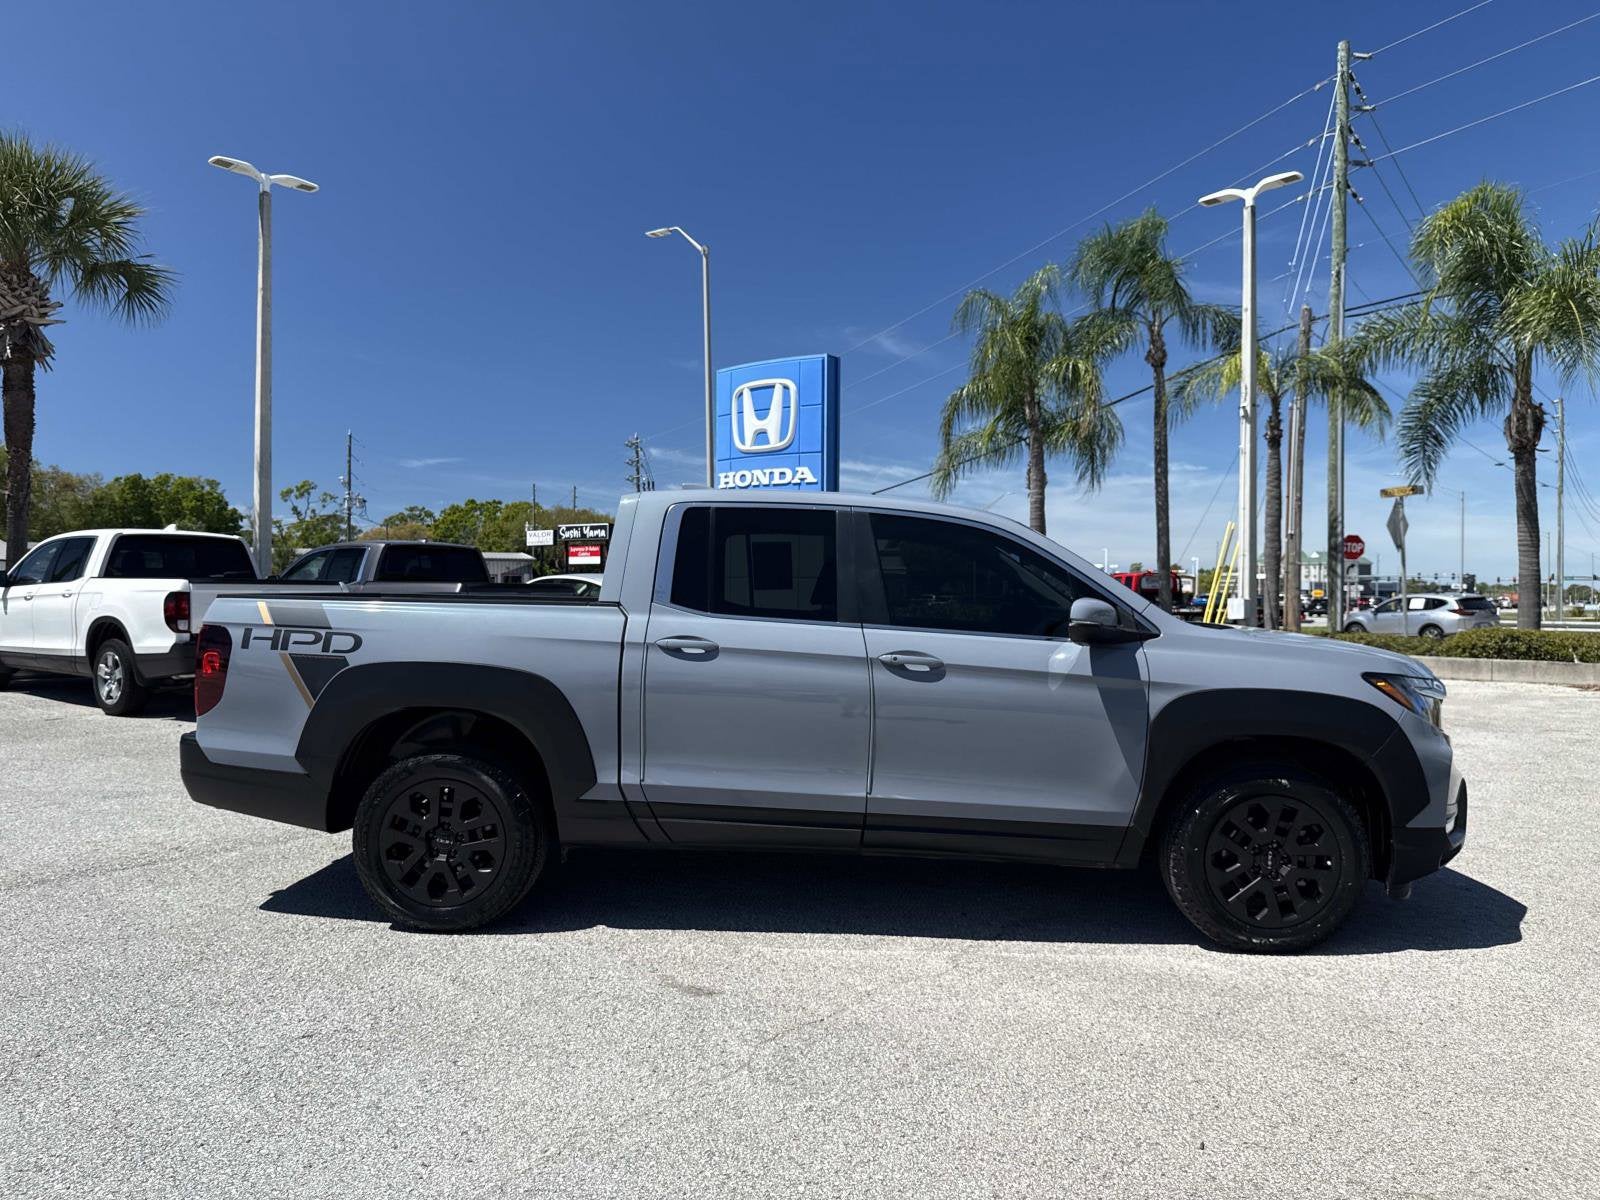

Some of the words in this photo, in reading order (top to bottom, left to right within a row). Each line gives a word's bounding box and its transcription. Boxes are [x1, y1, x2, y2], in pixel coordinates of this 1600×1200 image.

[718, 466, 817, 489] HONDA
[559, 526, 581, 539] Sushi
[582, 526, 606, 538] Yama
[240, 627, 363, 654] HPD
